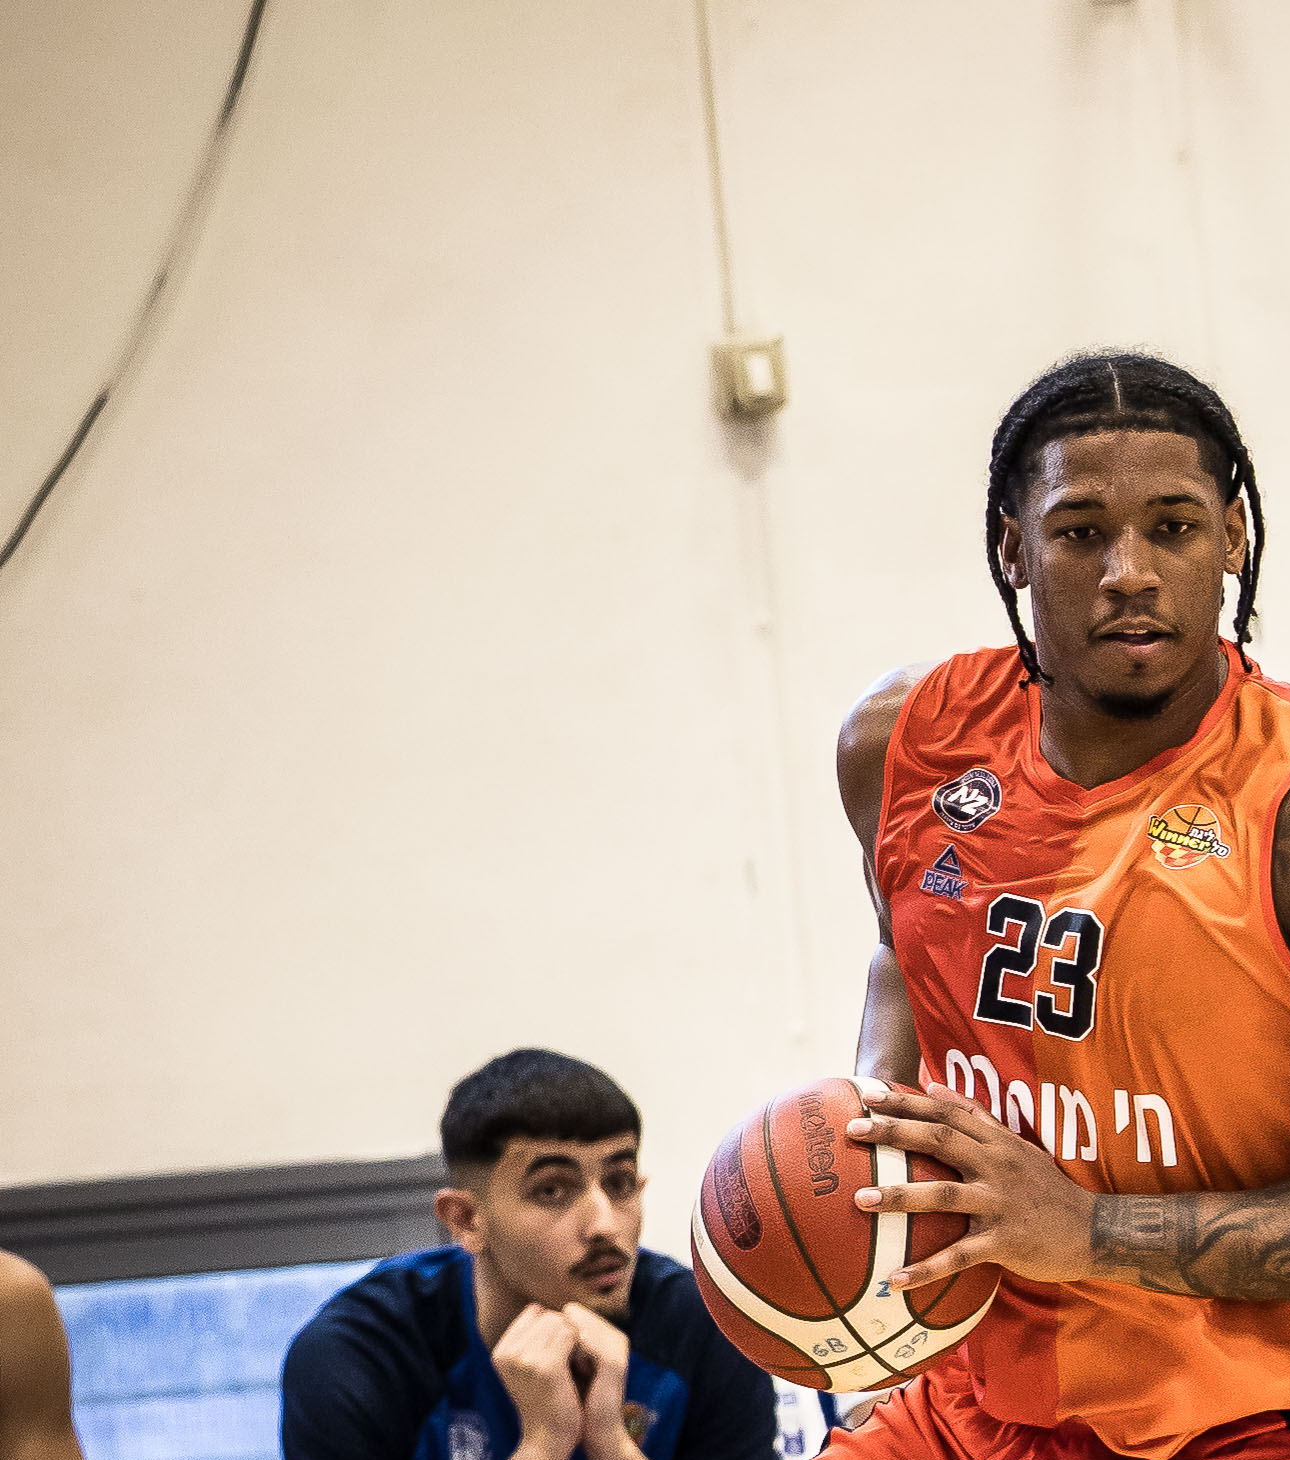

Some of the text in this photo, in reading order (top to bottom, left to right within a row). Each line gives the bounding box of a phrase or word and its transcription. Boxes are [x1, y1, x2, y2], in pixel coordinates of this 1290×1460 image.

[1147, 815, 1213, 852] Winner
[920, 868, 968, 901] PEAK
[972, 892, 1106, 1042] 23
[799, 1090, 840, 1198] molten
[1114, 1088, 1178, 1166] חי
